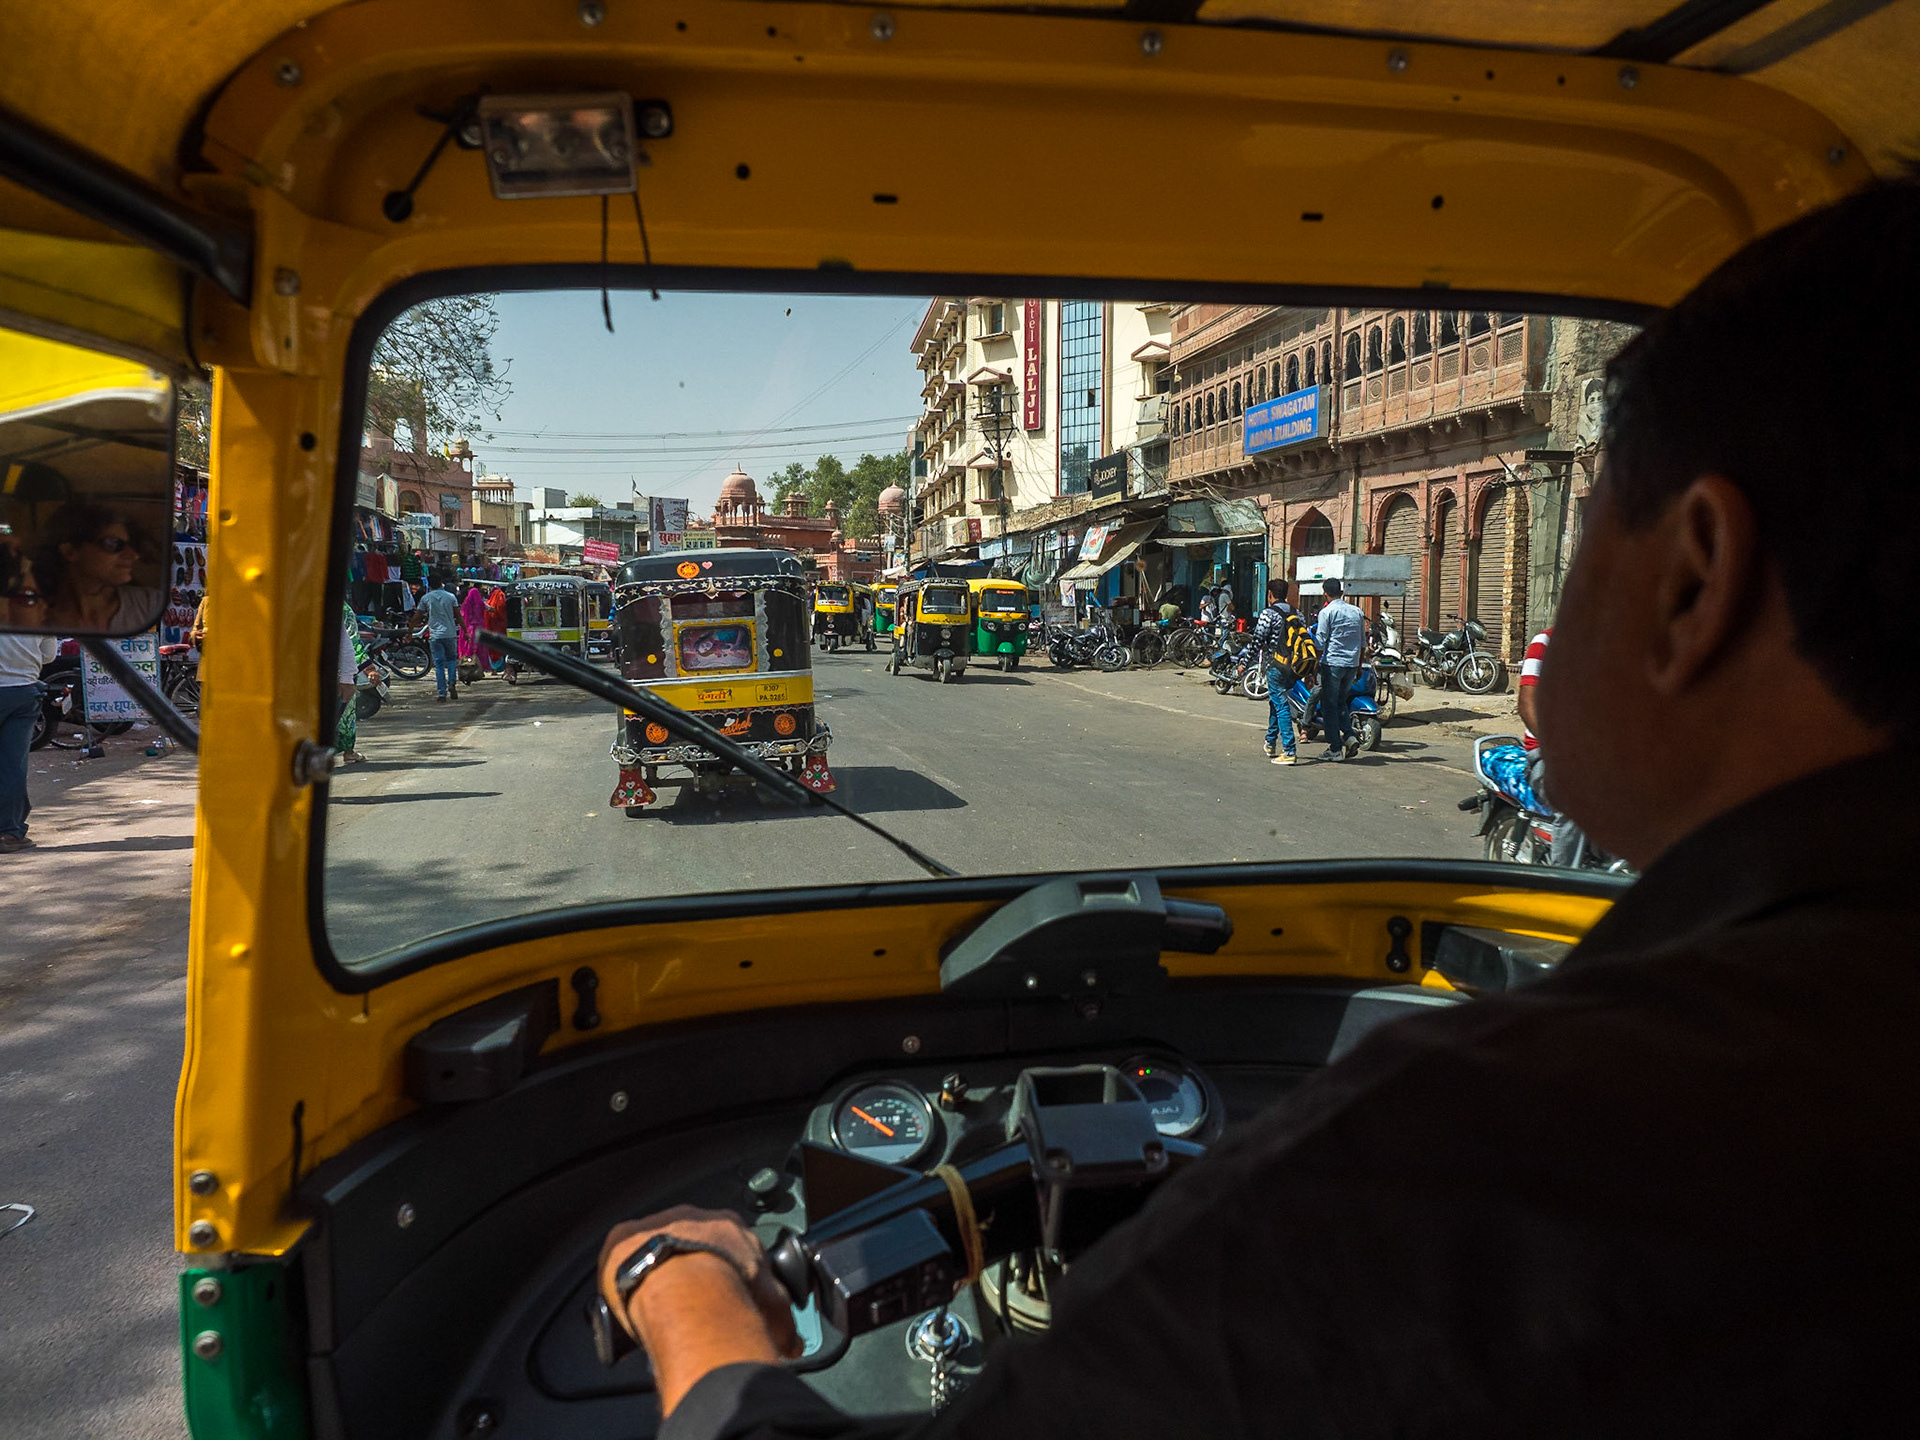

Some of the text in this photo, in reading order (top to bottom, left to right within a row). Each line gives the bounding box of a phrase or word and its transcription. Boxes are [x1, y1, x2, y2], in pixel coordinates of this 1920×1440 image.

[1026, 299, 1038, 424] otel LALJI
[1271, 393, 1316, 422] SWAGATAM
[1274, 417, 1312, 441] BUILDING
